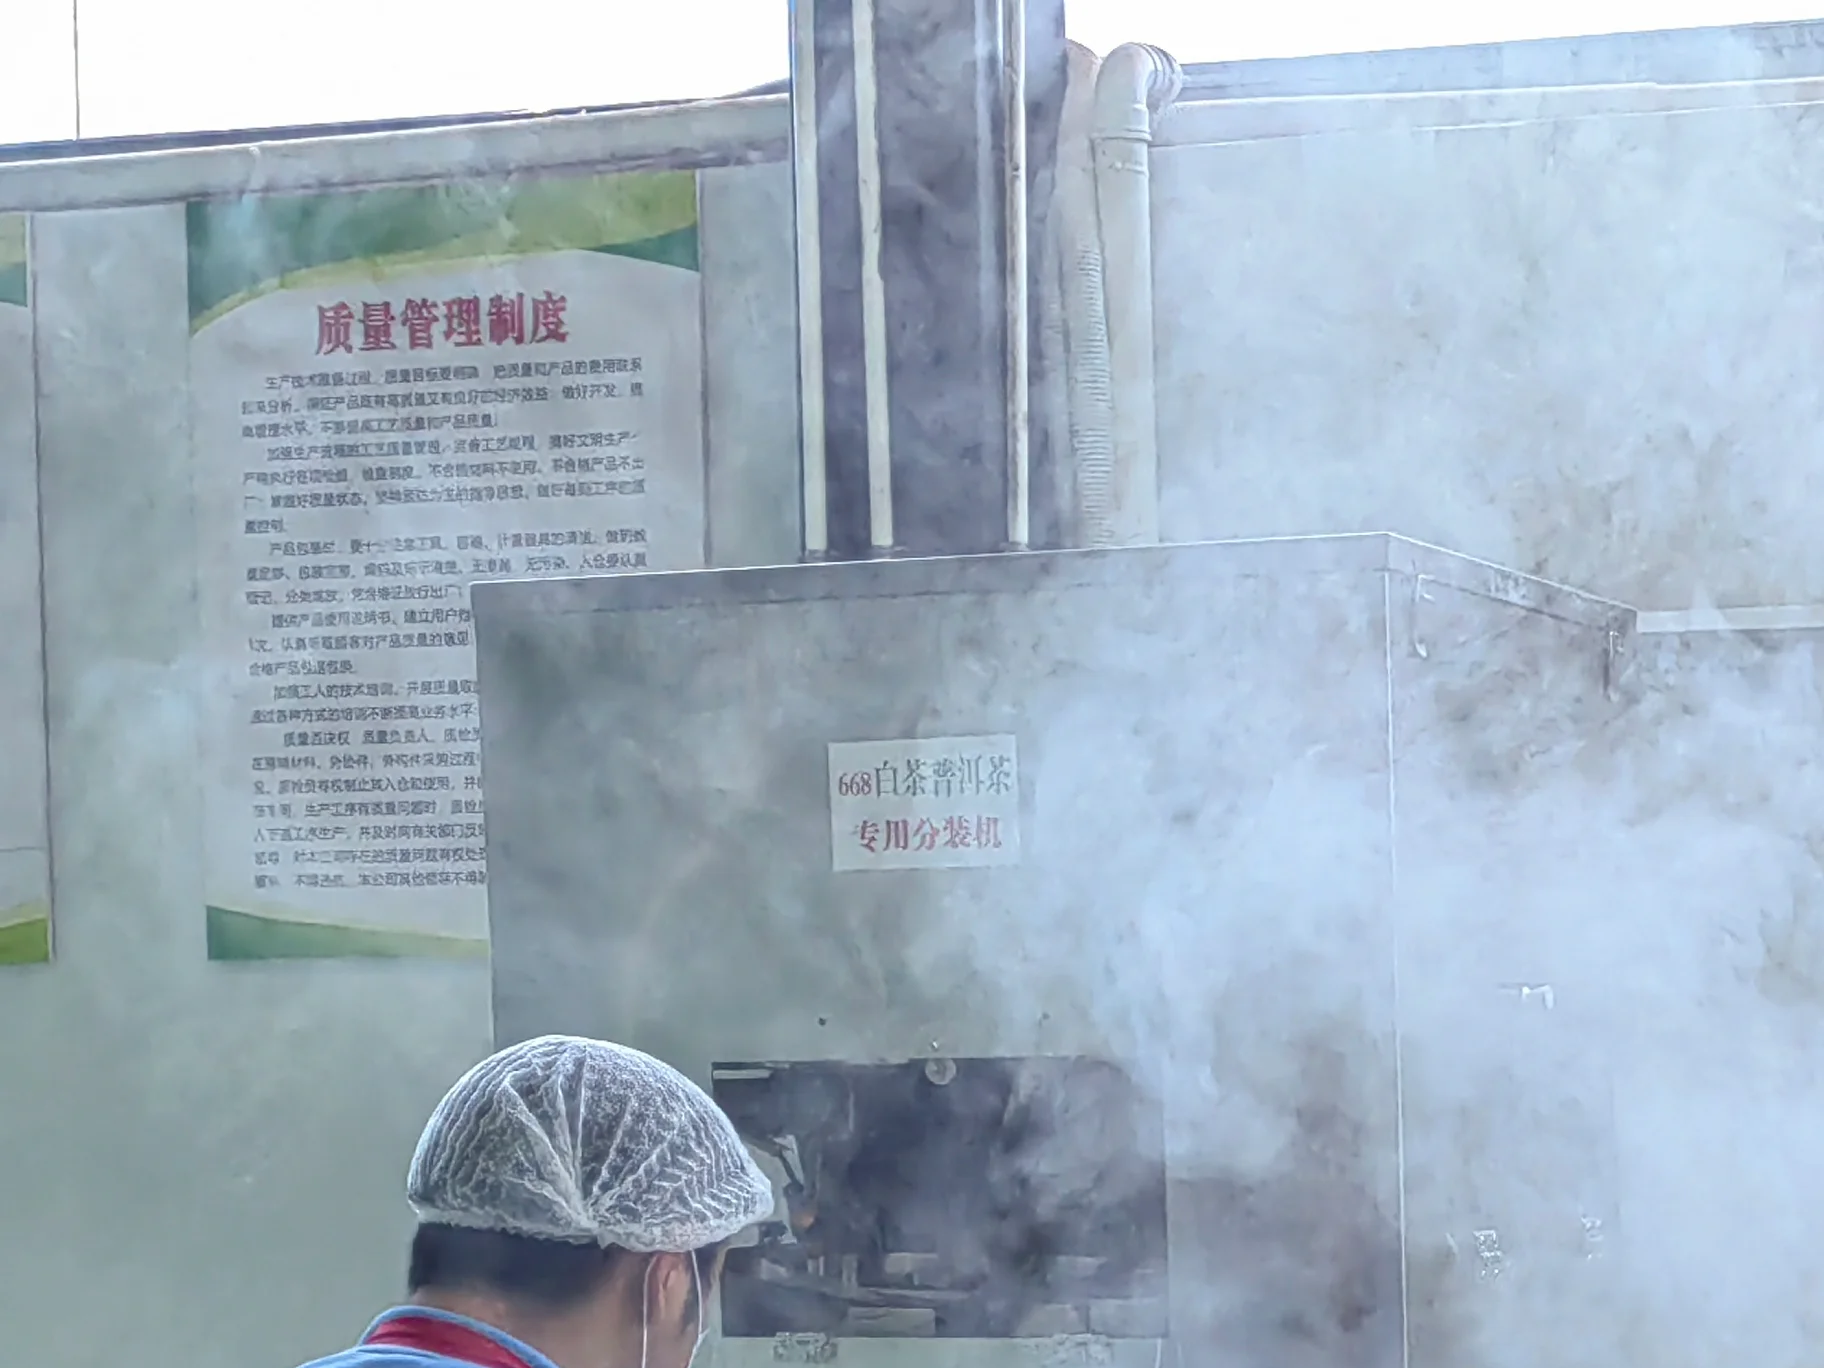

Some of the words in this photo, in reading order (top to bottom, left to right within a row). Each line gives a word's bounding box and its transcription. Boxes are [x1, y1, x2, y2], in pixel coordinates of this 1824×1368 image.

[315, 289, 570, 355] 质量管理制度
